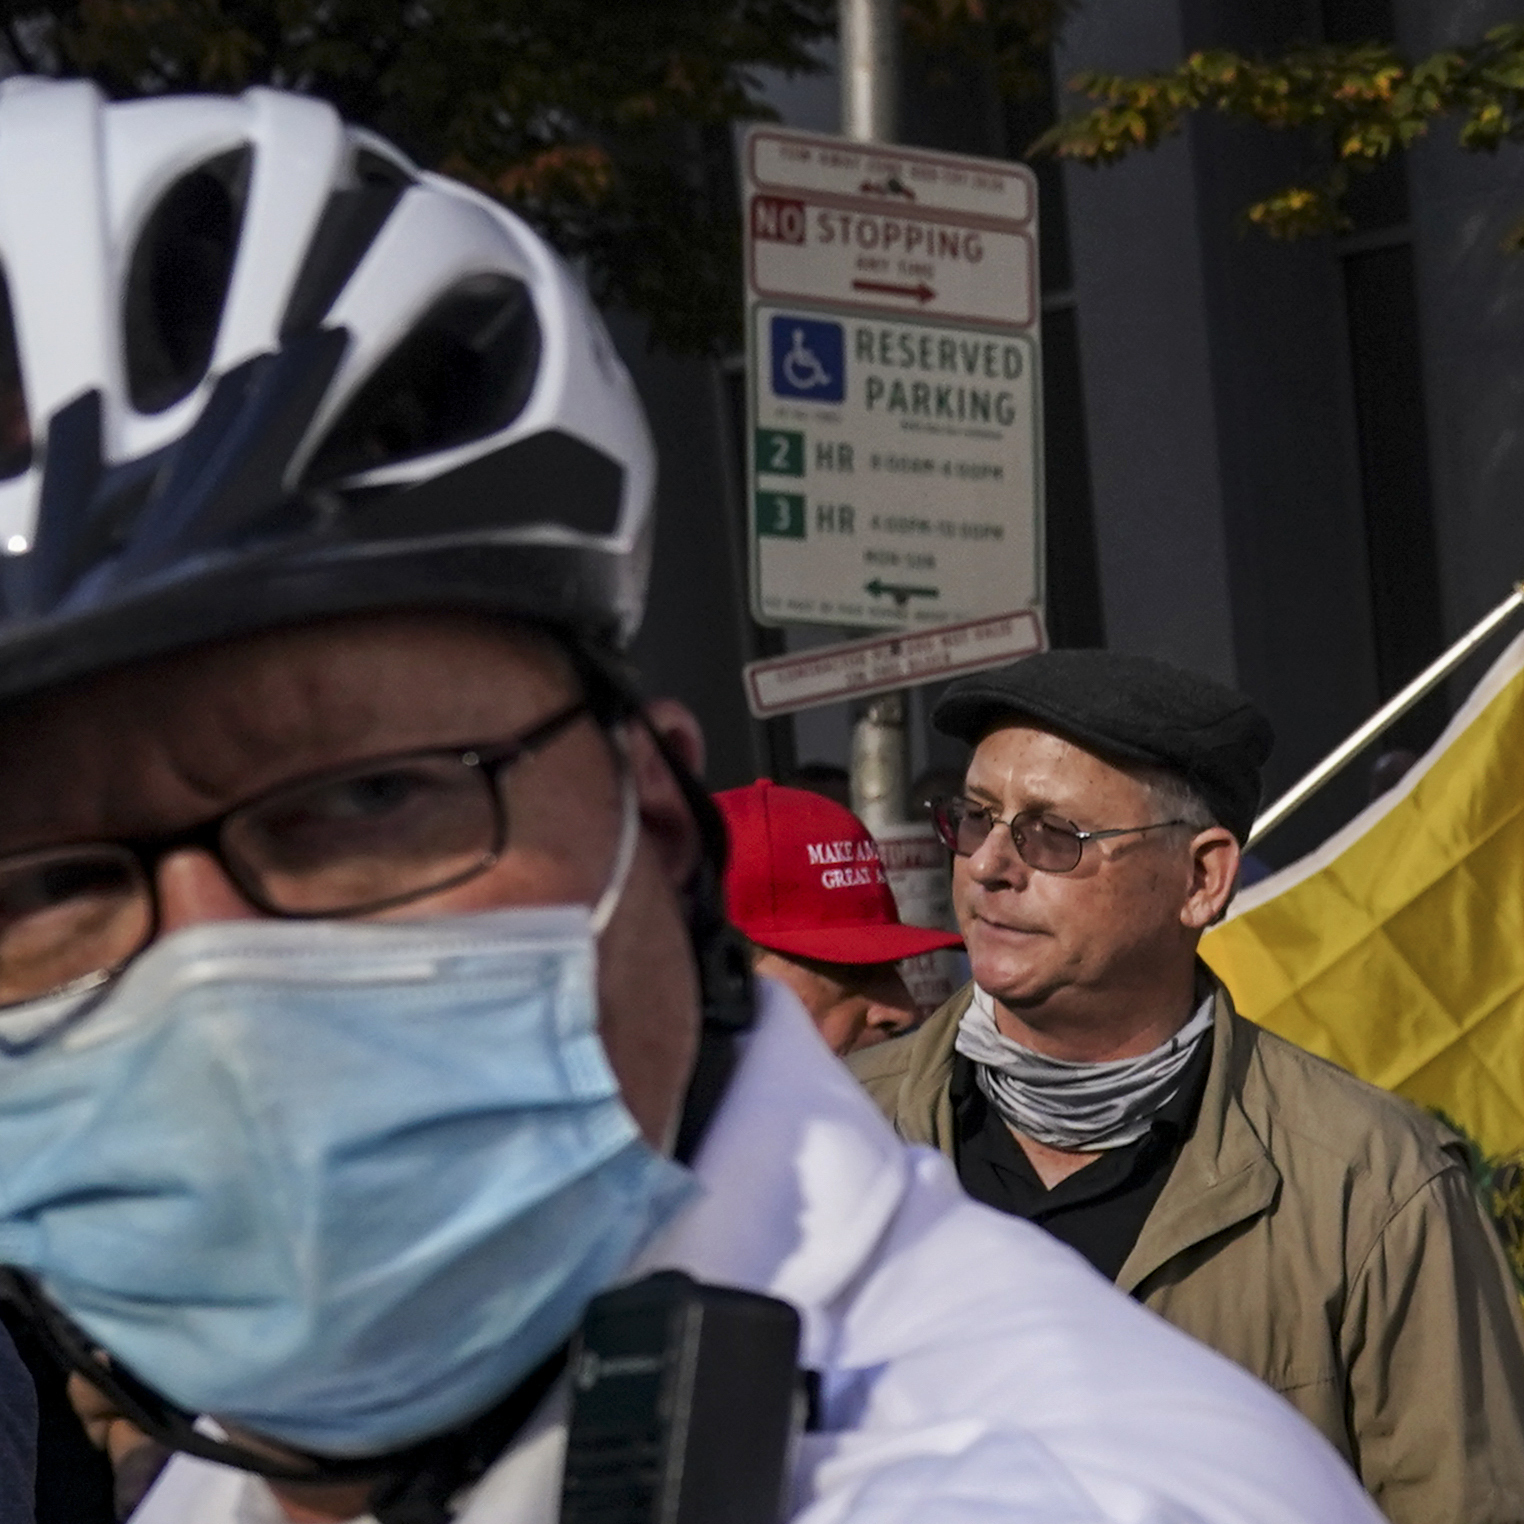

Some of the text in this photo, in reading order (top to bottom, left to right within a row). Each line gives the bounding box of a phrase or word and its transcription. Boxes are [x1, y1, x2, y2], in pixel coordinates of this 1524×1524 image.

[756, 202, 984, 264] NO STOPPING
[854, 327, 1024, 381] RESERVED
[864, 375, 1017, 427] PARKING
[769, 436, 791, 470] 2
[815, 441, 855, 474] HR
[774, 498, 792, 532] 3
[815, 503, 856, 536] HR
[807, 841, 854, 865] MAKE
[821, 867, 872, 890] GREAT
